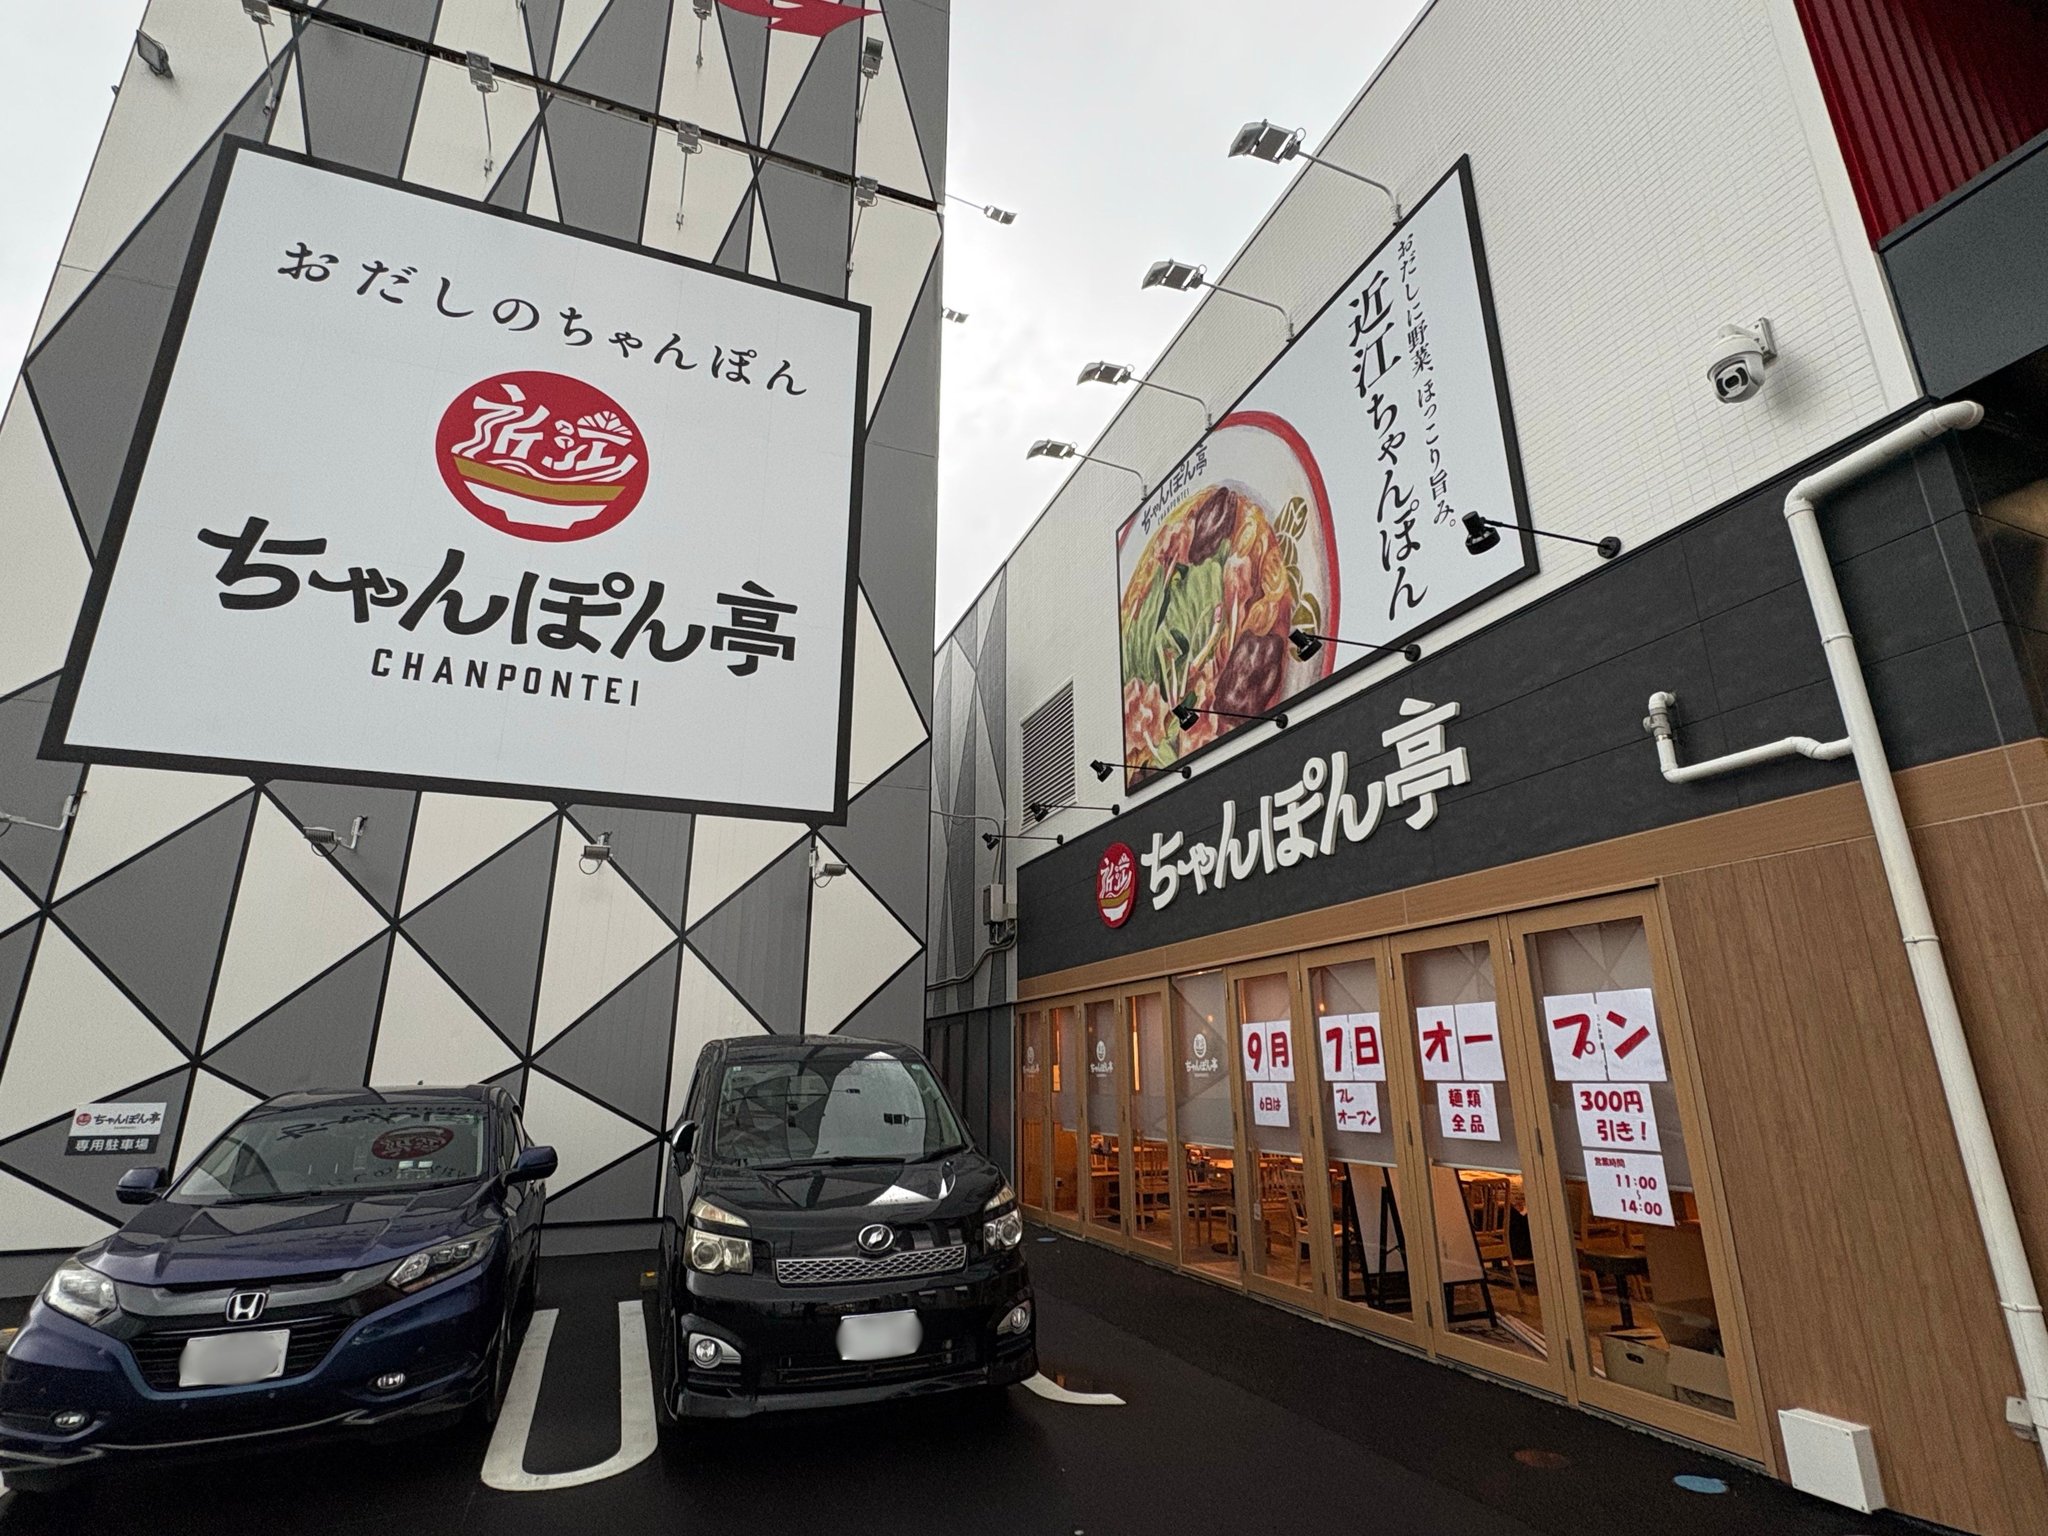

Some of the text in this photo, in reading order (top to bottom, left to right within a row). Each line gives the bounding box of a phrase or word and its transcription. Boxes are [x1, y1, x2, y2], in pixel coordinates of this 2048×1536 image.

[277, 241, 808, 397] おだしのちゃんぽん
[1348, 269, 1429, 621] 近江ちゃんぽん
[1141, 443, 1208, 535] ちゃんぽん亭
[198, 515, 799, 676] ちゃんぽん亭
[371, 648, 641, 708] CHANPONTEI
[1140, 697, 1471, 911] ちゃんぽん亭
[1247, 1010, 1651, 1073] 9月 7日 オー プン
[1259, 1097, 1282, 1112] 6日は
[1580, 1090, 1644, 1113] 300円
[93, 1111, 161, 1125] ちゃんぽん亭
[1337, 1109, 1377, 1127] オープン
[1452, 1113, 1485, 1133] 全品
[75, 1138, 150, 1152] 専用駐車場
[1616, 1174, 1657, 1191] 11:00
[1621, 1198, 1663, 1216] 14:00
